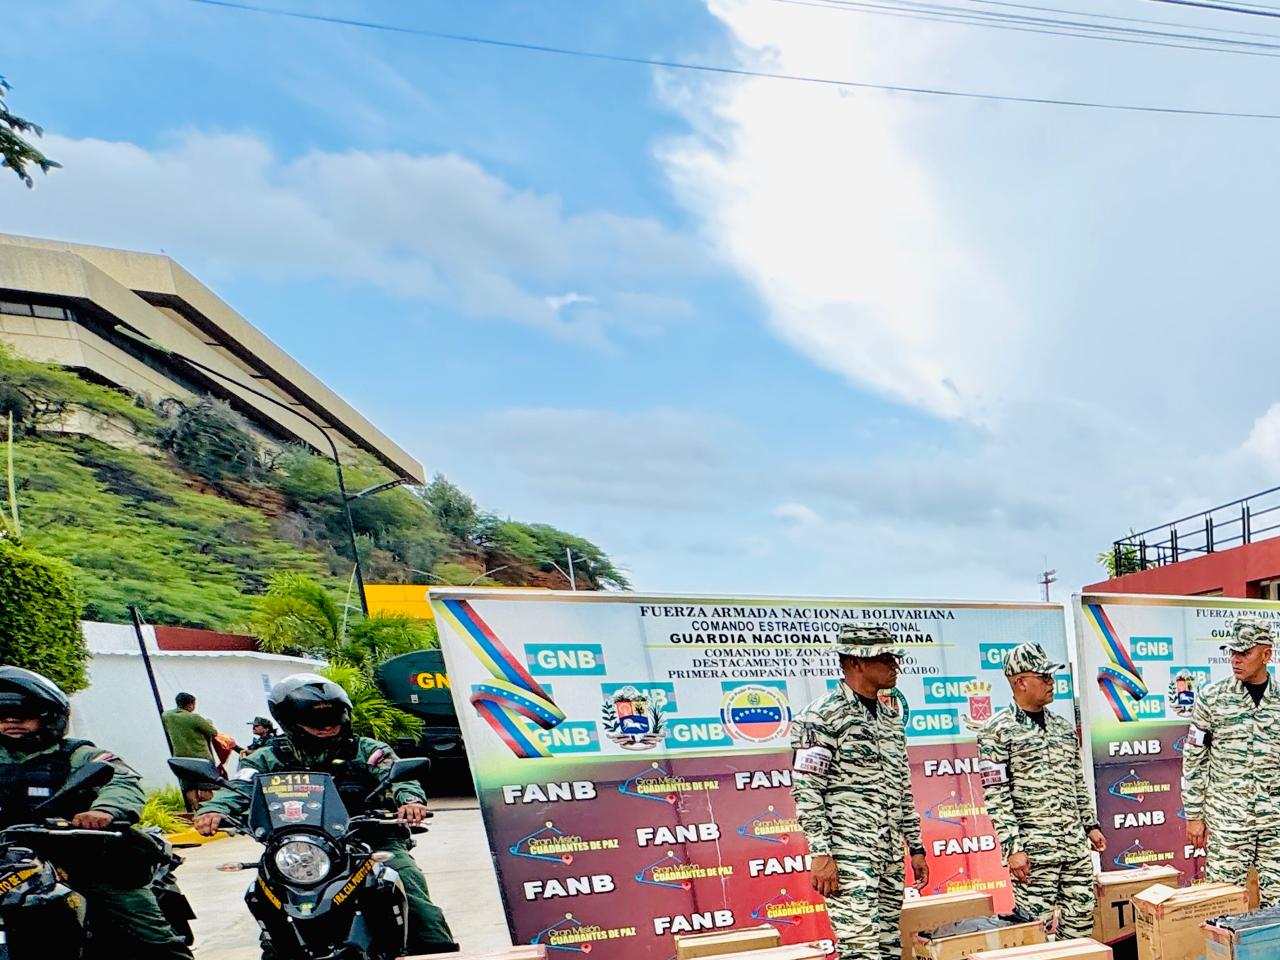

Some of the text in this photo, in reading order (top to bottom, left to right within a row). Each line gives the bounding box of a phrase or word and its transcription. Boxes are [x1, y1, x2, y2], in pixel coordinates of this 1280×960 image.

[640, 606, 955, 620] FUERZA ARMADA NACIONAL BOLIVARIANA
[1196, 609, 1234, 618] FUERZA
[692, 621, 755, 632] COMANDO
[669, 633, 831, 644] GUARDIA NACIONAL
[705, 649, 771, 658] COMANDO
[776, 649, 792, 657] DE
[1136, 642, 1169, 656] GNB
[537, 650, 596, 669] GNB
[692, 658, 837, 668] DESTACAMENTO 111
[668, 667, 796, 679] PRIMERA COMPAÑÍA
[1130, 700, 1161, 714] GNB
[912, 714, 954, 730] GNB
[534, 728, 590, 746] GNB
[673, 724, 725, 741] GNB
[1109, 740, 1161, 756] FANB
[925, 760, 979, 776] FAN
[637, 780, 719, 794] CUADRANTES DE PAZ
[735, 770, 792, 790] FAN
[502, 780, 597, 804] FANB
[1114, 811, 1166, 829] FANB
[636, 823, 720, 847] FANB
[530, 839, 619, 855] CUADRANTES DE PAZ
[933, 835, 995, 857] FANB
[653, 866, 733, 883] CUADRANTES DE PAZ
[524, 874, 615, 900] FANB
[654, 910, 735, 935] FANB
[550, 927, 636, 945] CUADRANTES DE PAZ
